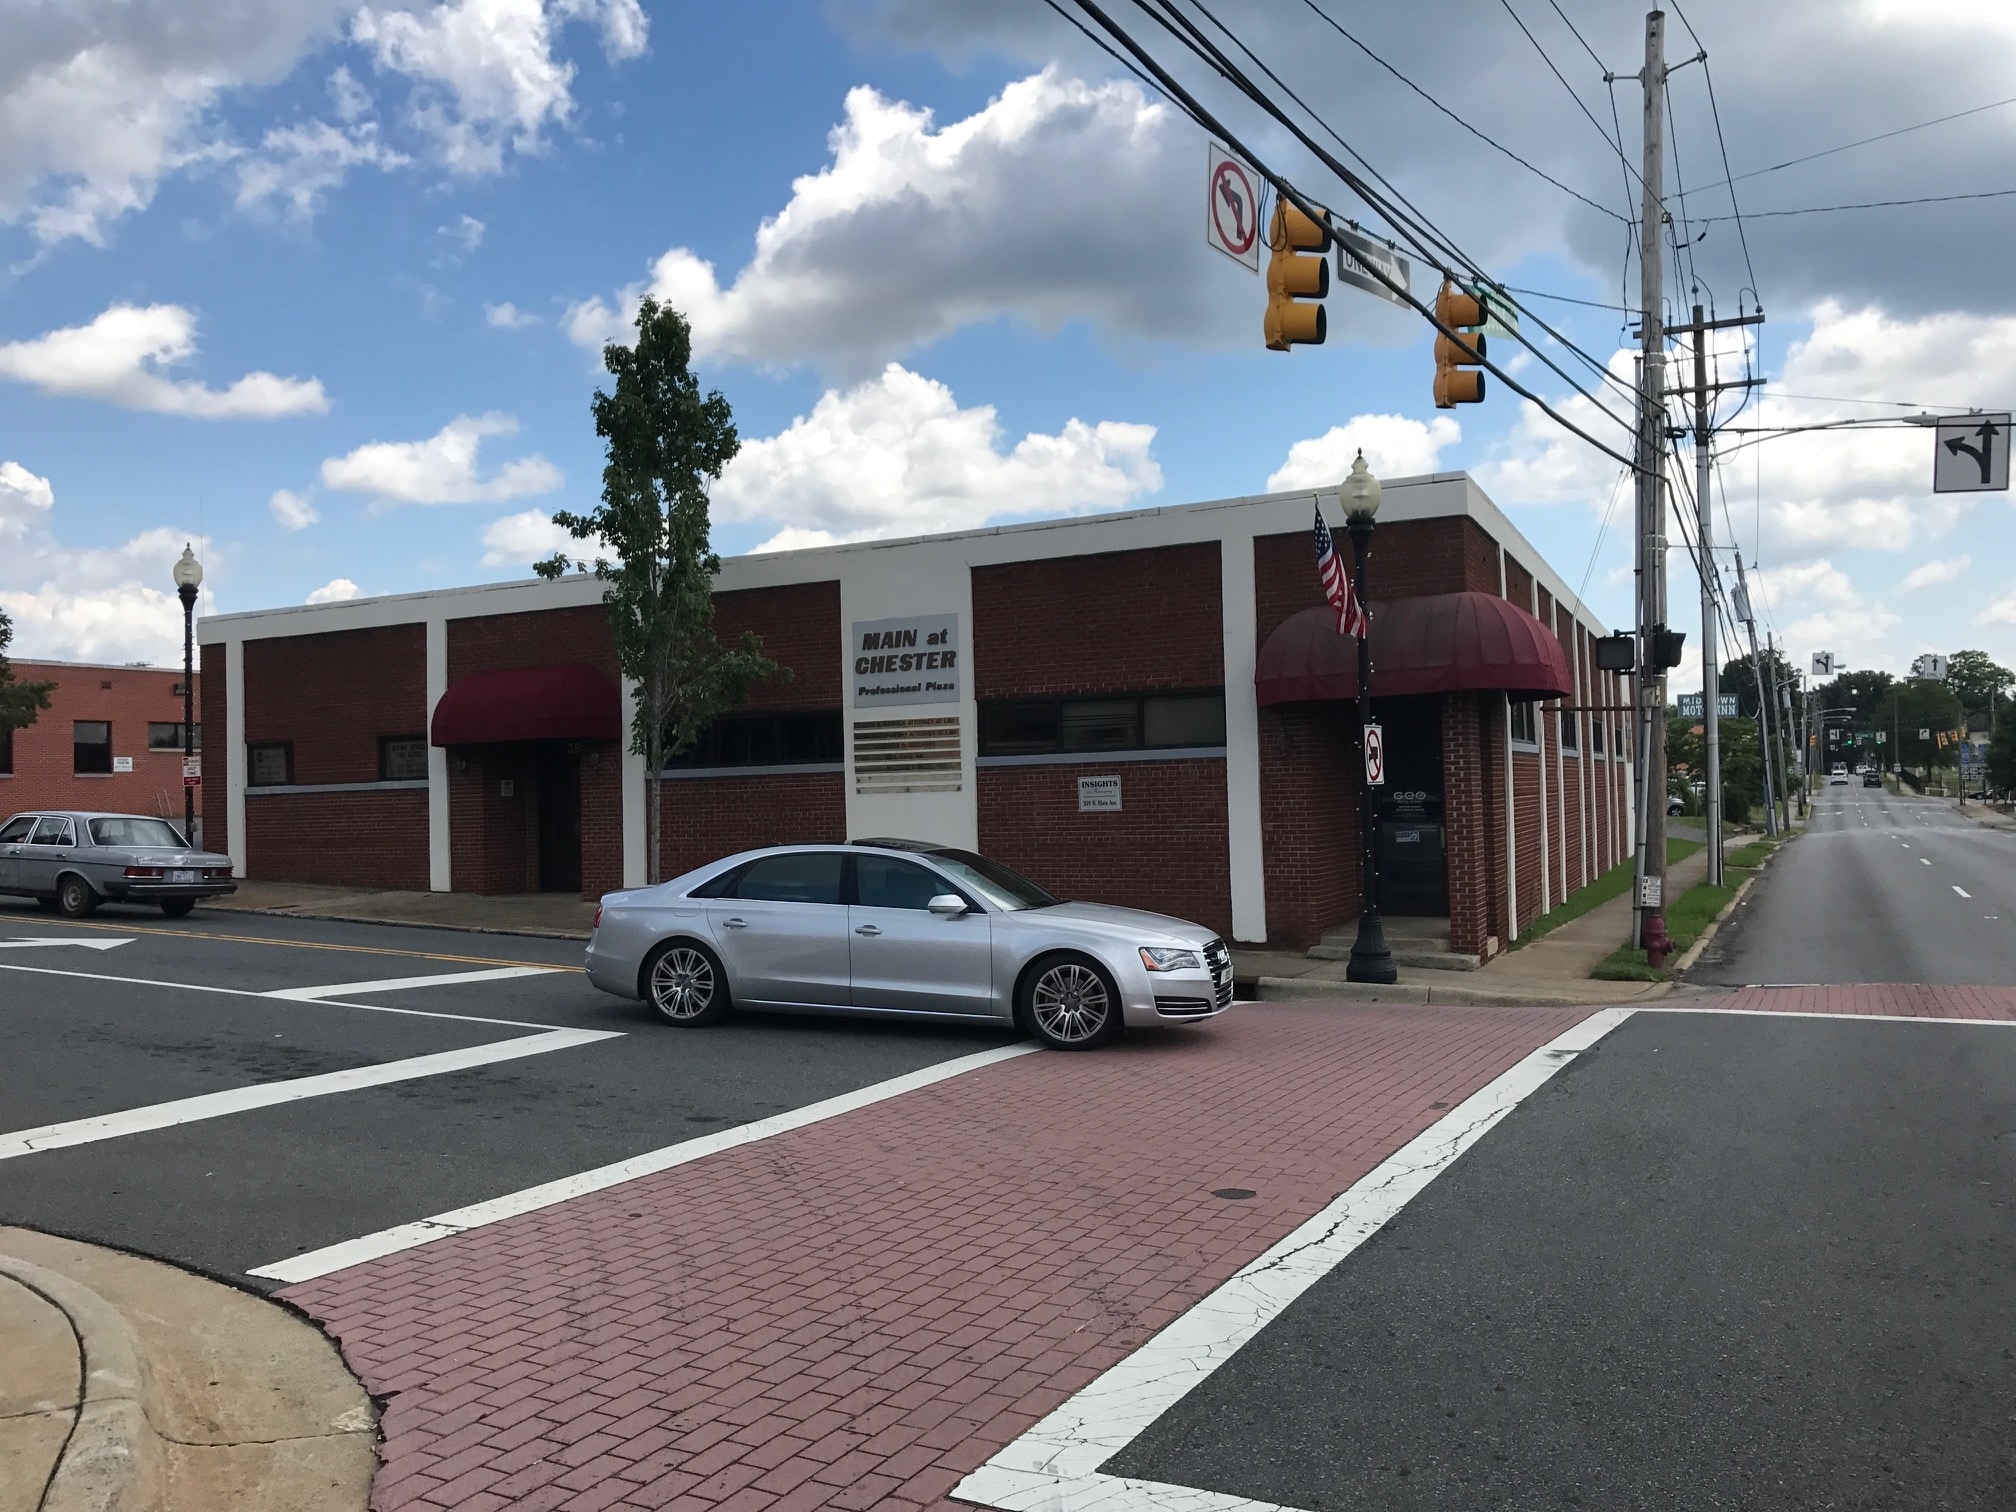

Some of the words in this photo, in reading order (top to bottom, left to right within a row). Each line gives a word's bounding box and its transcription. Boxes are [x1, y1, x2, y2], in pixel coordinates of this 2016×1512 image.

[862, 629, 917, 651] MAIN
[927, 628, 948, 645] at
[855, 650, 956, 674] CHESTER
[858, 683, 921, 695] Professional
[925, 682, 954, 691] Plaza
[1682, 696, 1735, 704] MIDWN
[1081, 780, 1118, 788] INSIGHTS
[1393, 791, 1427, 800] GEO
